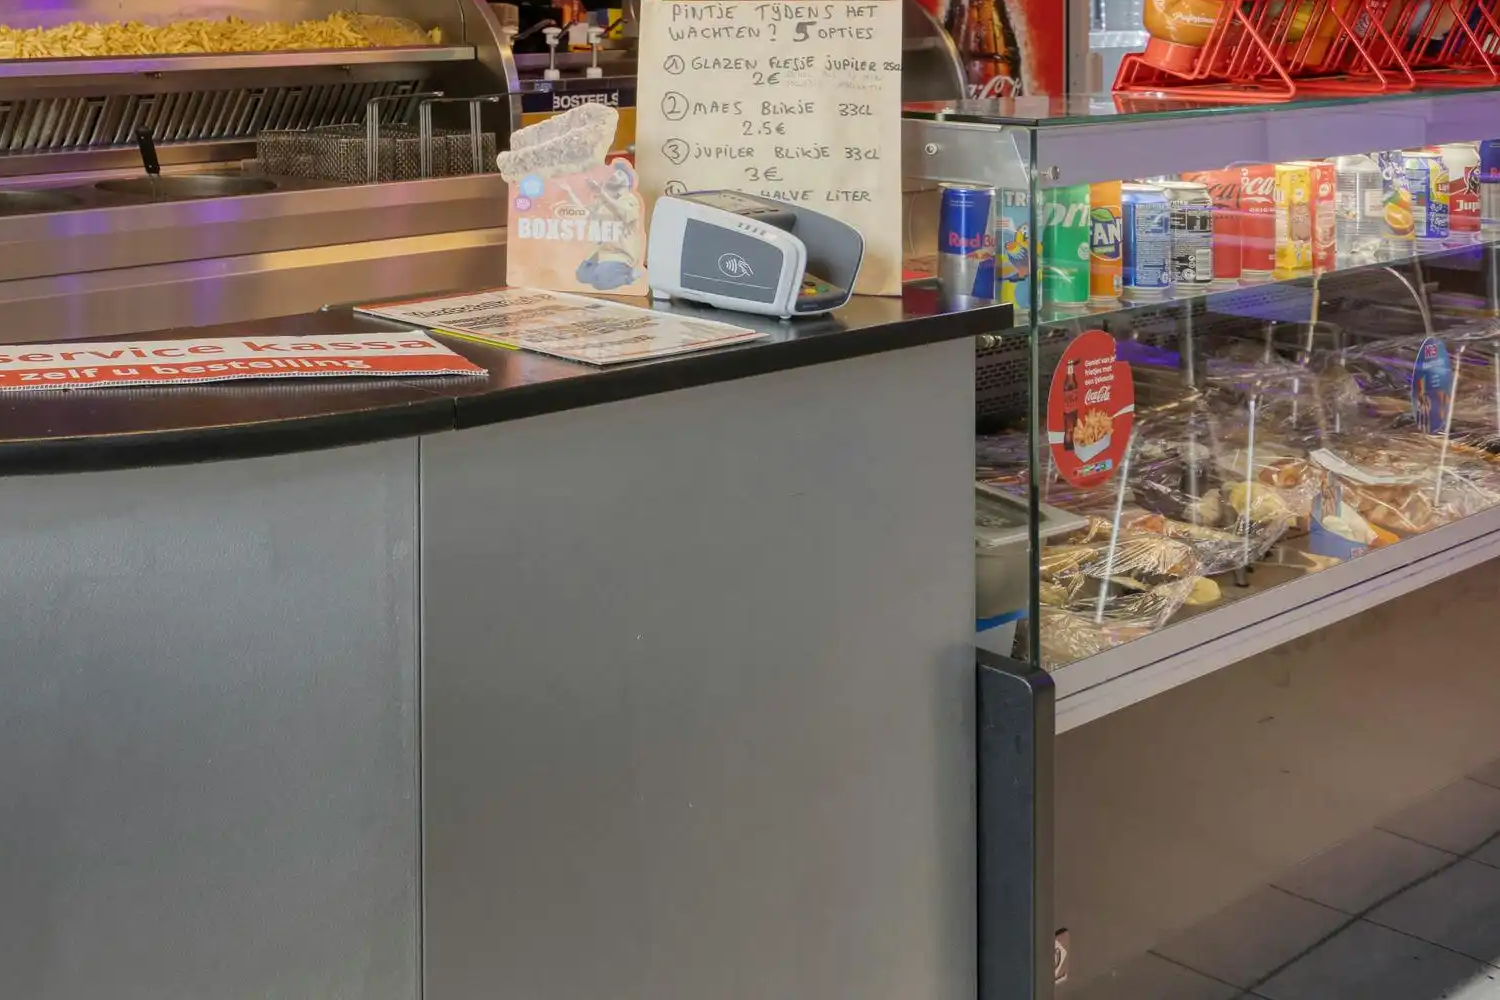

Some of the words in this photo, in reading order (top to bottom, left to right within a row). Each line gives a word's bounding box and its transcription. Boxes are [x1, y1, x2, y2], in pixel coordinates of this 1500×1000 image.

[846, 5, 879, 18] HET
[668, 26, 761, 42] WACHTEN
[792, 21, 817, 42] 5
[691, 56, 758, 71] GLAZEN
[553, 92, 619, 109] BOSTEELS
[692, 101, 743, 115] MAES
[558, 207, 586, 217] mora
[948, 230, 981, 248] Red
[241, 338, 437, 353] kassa
[19, 366, 101, 382] zelf
[111, 365, 139, 377] u
[149, 354, 373, 375] bestelling
